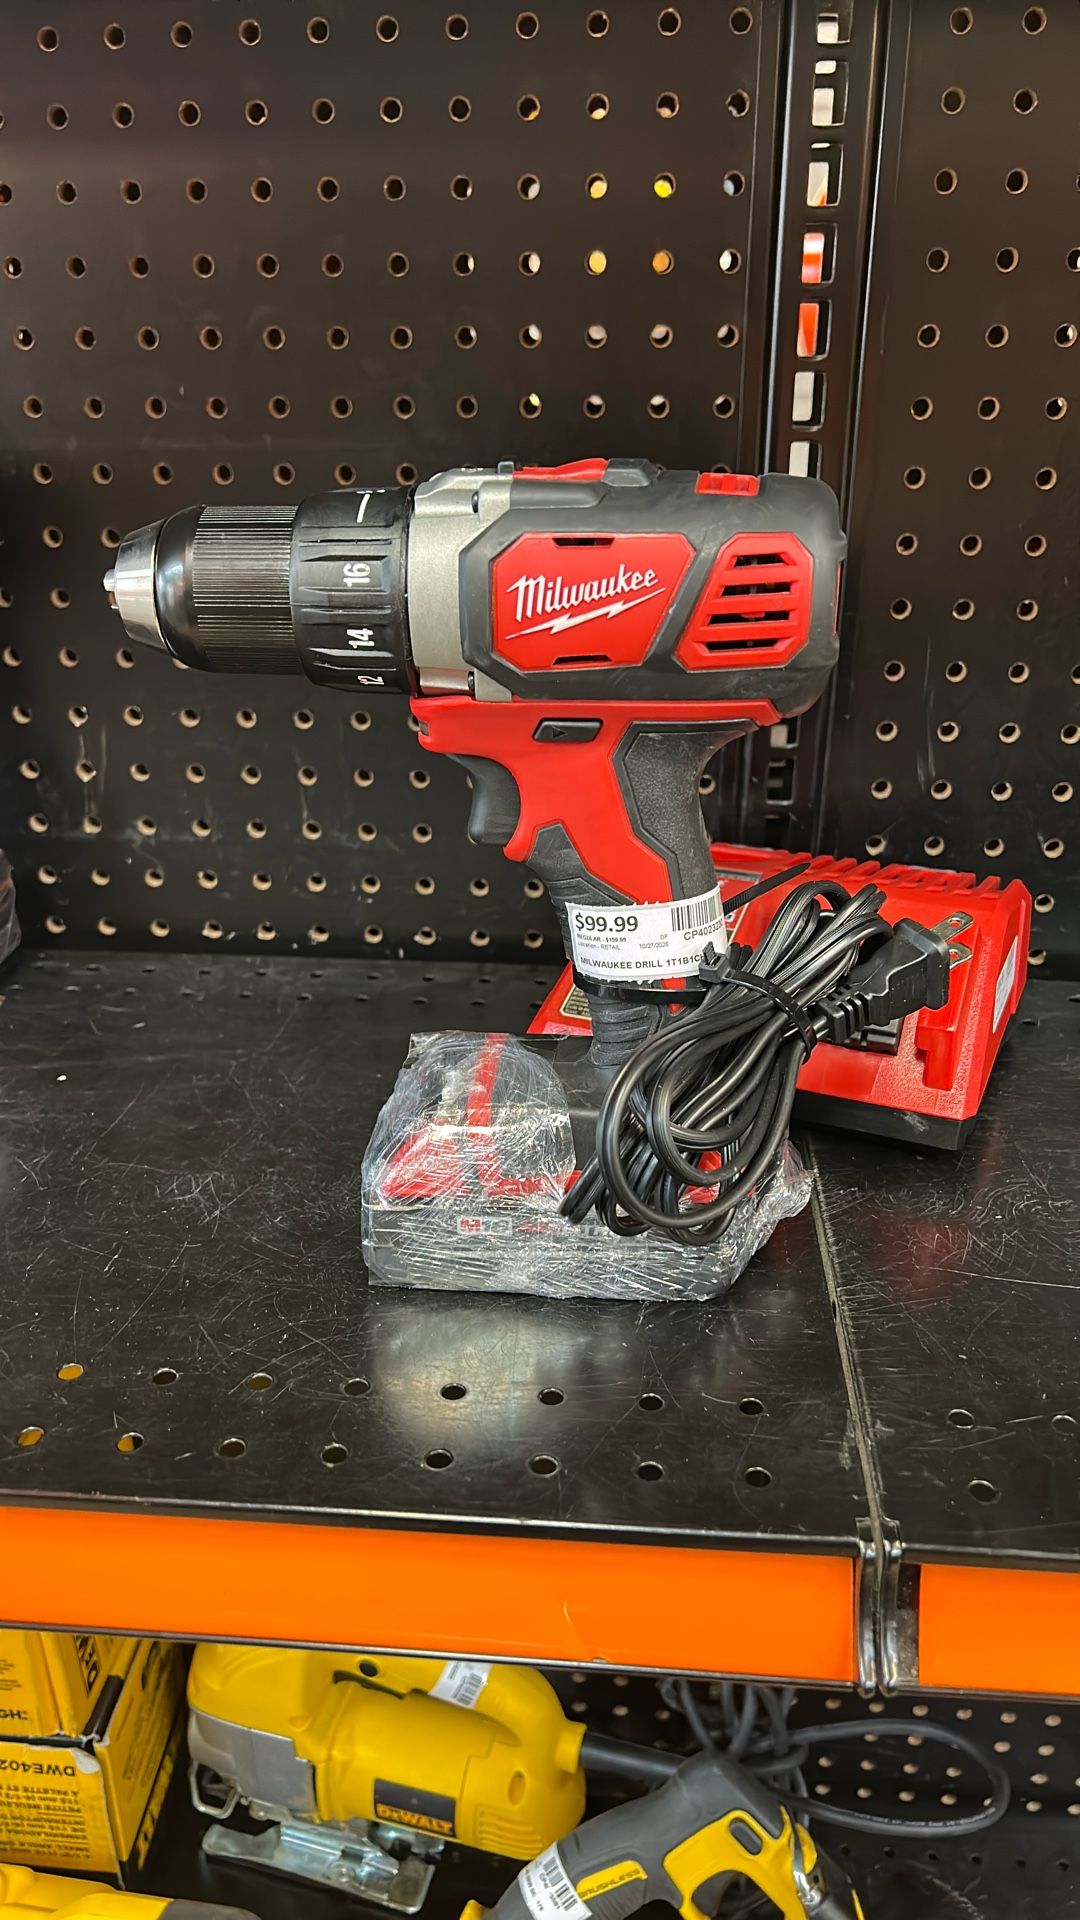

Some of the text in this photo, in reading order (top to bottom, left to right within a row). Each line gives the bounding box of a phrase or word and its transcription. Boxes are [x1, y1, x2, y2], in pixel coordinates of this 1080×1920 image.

[343, 562, 371, 588] 16
[506, 563, 659, 623] Milwaukee
[346, 627, 375, 649] 14
[575, 912, 639, 932] $99.99
[576, 933, 601, 943] REGULAR
[580, 957, 633, 969] MILWAUKEE
[635, 960, 664, 969] DRILL
